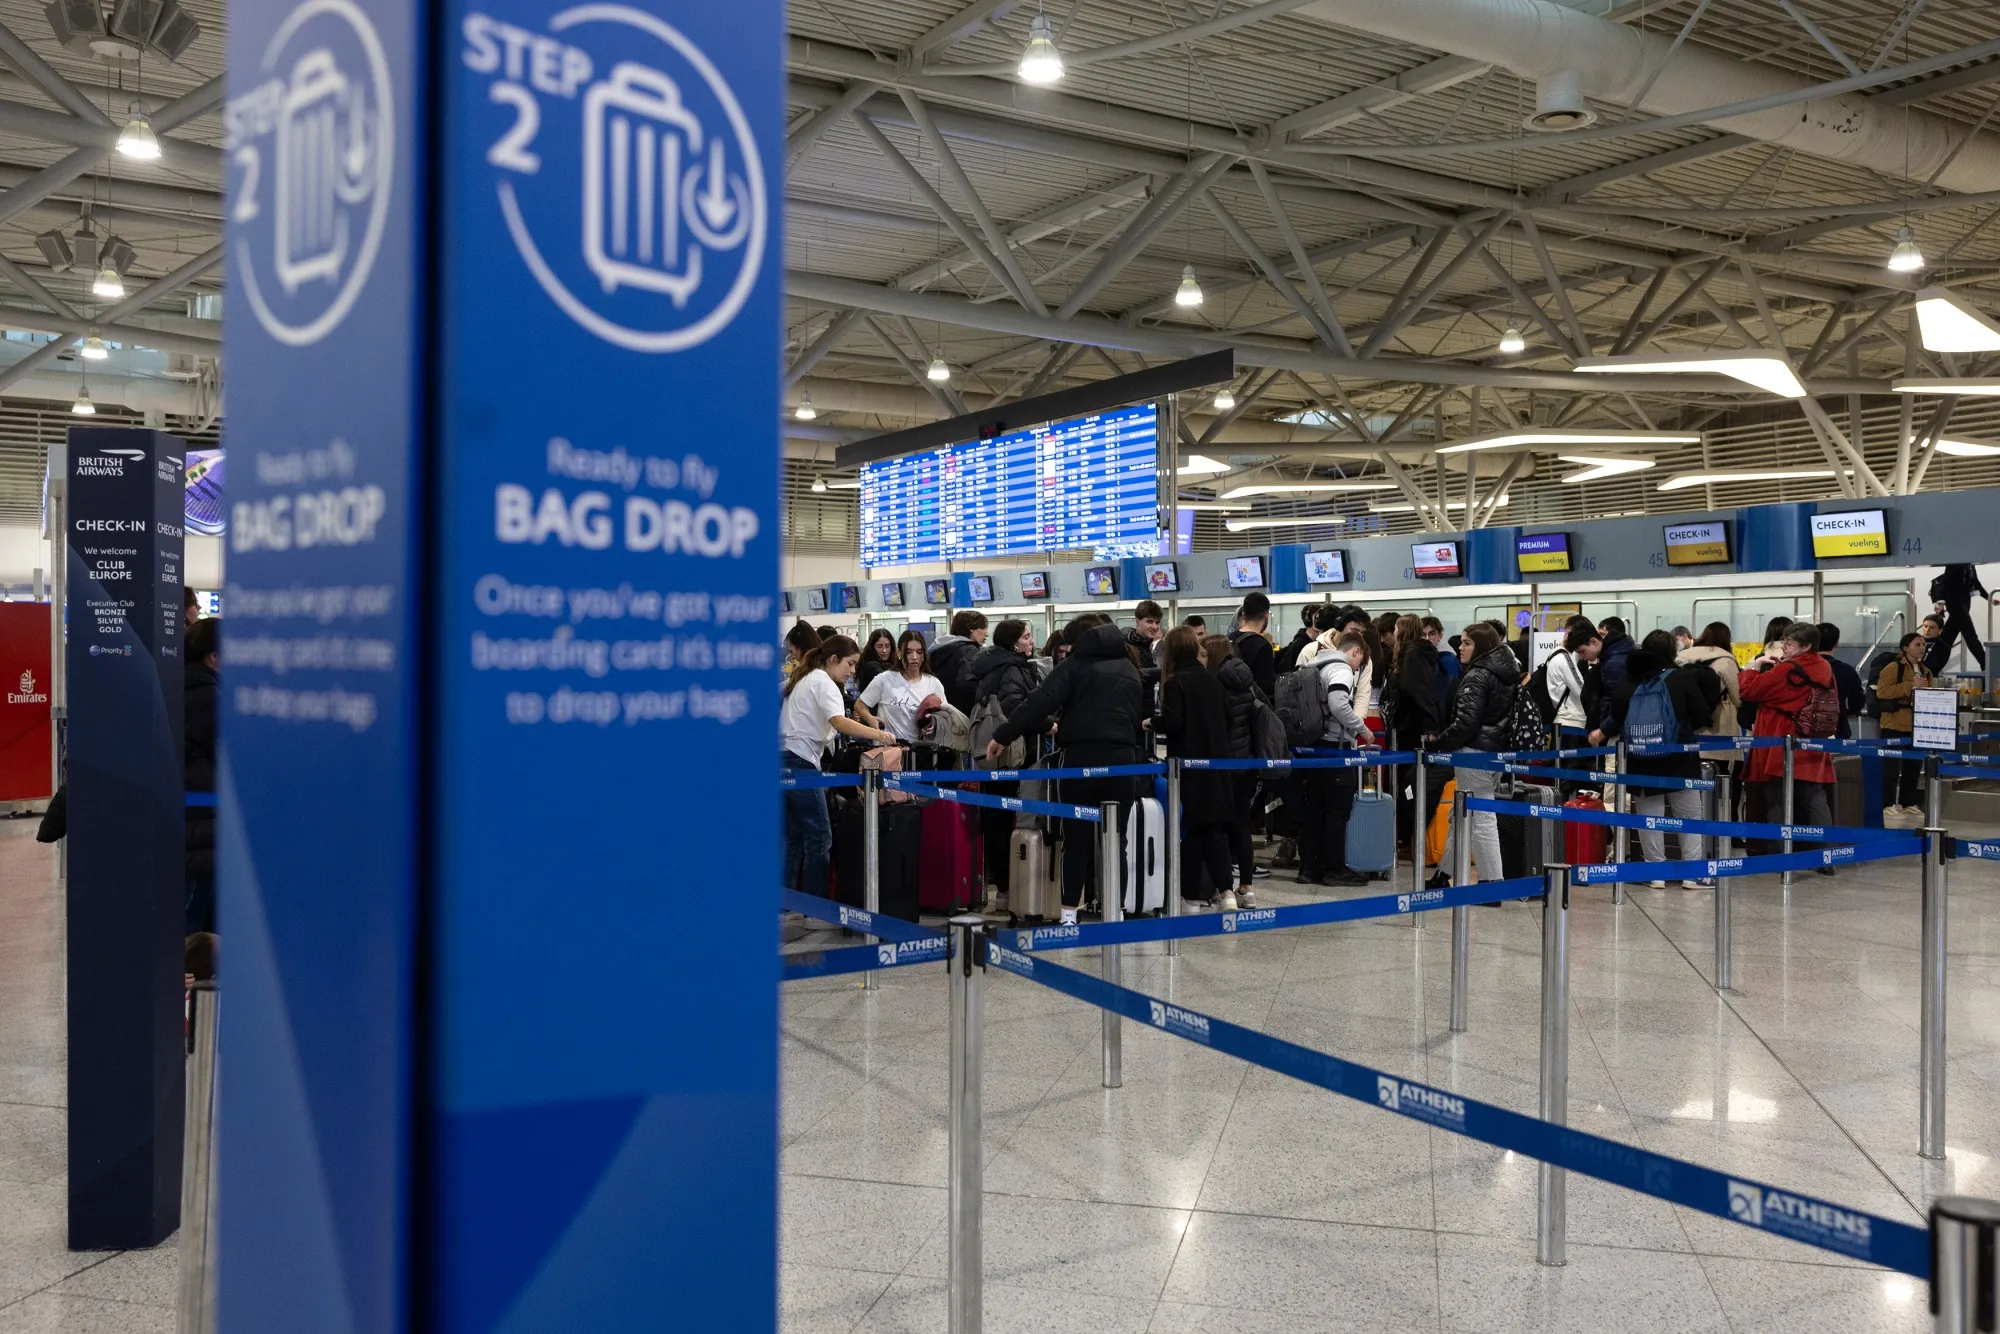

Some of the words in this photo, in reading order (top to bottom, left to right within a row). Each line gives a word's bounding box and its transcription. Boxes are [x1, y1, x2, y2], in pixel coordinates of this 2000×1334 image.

[462, 13, 594, 99] STEP
[486, 82, 542, 175] 2
[78, 456, 122, 466] BRITISH
[158, 460, 176, 474] BRITISH
[76, 466, 124, 476] AIRWAYS
[546, 437, 640, 492] Ready
[645, 454, 680, 490] to
[682, 454, 719, 499] fly
[231, 495, 291, 554] BAG
[295, 484, 386, 549] DROP
[494, 483, 613, 551] BAG
[624, 496, 759, 559] DROP
[1816, 518, 1866, 531] CHECK-IN
[76, 520, 146, 532] CHECK-IN
[157, 522, 183, 538] CHECK-IN
[1668, 528, 1710, 540] CHECK-IN
[1519, 540, 1550, 550] PREMIUM
[1848, 536, 1880, 550] vueling
[1903, 538, 1922, 554] 44
[84, 546, 99, 555] We
[100, 546, 137, 555] welcome
[1696, 546, 1722, 557] vueling
[96, 560, 125, 569] CLUB
[1542, 556, 1564, 566] vueling
[1582, 557, 1596, 572] 46
[1648, 552, 1664, 567] 45
[90, 571, 132, 580] EUROPE
[1356, 570, 1366, 582] 48
[1402, 568, 1414, 580] 47
[1185, 580, 1194, 592] 50
[473, 573, 565, 620] Once
[566, 583, 660, 626] you've
[663, 591, 712, 628] got
[714, 595, 773, 629] your
[471, 624, 610, 680] boarding
[610, 634, 674, 672] card
[677, 633, 714, 671] it's
[715, 640, 775, 672] time
[8, 692, 48, 704] Emirates
[504, 691, 546, 725] to
[547, 685, 619, 726] drop
[619, 691, 686, 728] your
[687, 683, 751, 725] bags
[1539, 806, 1562, 814] ATHENS
[1832, 847, 1854, 856] ATHENS
[1588, 865, 1618, 874] ATHENS
[1718, 859, 1743, 868] ATHENS
[1411, 890, 1444, 902] ATHENS
[848, 909, 872, 922] ATHENS
[1237, 910, 1276, 922] ATHENS
[1034, 926, 1079, 938] ATHENS
[1001, 948, 1034, 966] ATHENS
[1166, 1006, 1210, 1030] ATHENS
[1400, 1083, 1465, 1116] ATHENS
[1764, 1192, 1872, 1238] ATHENS
